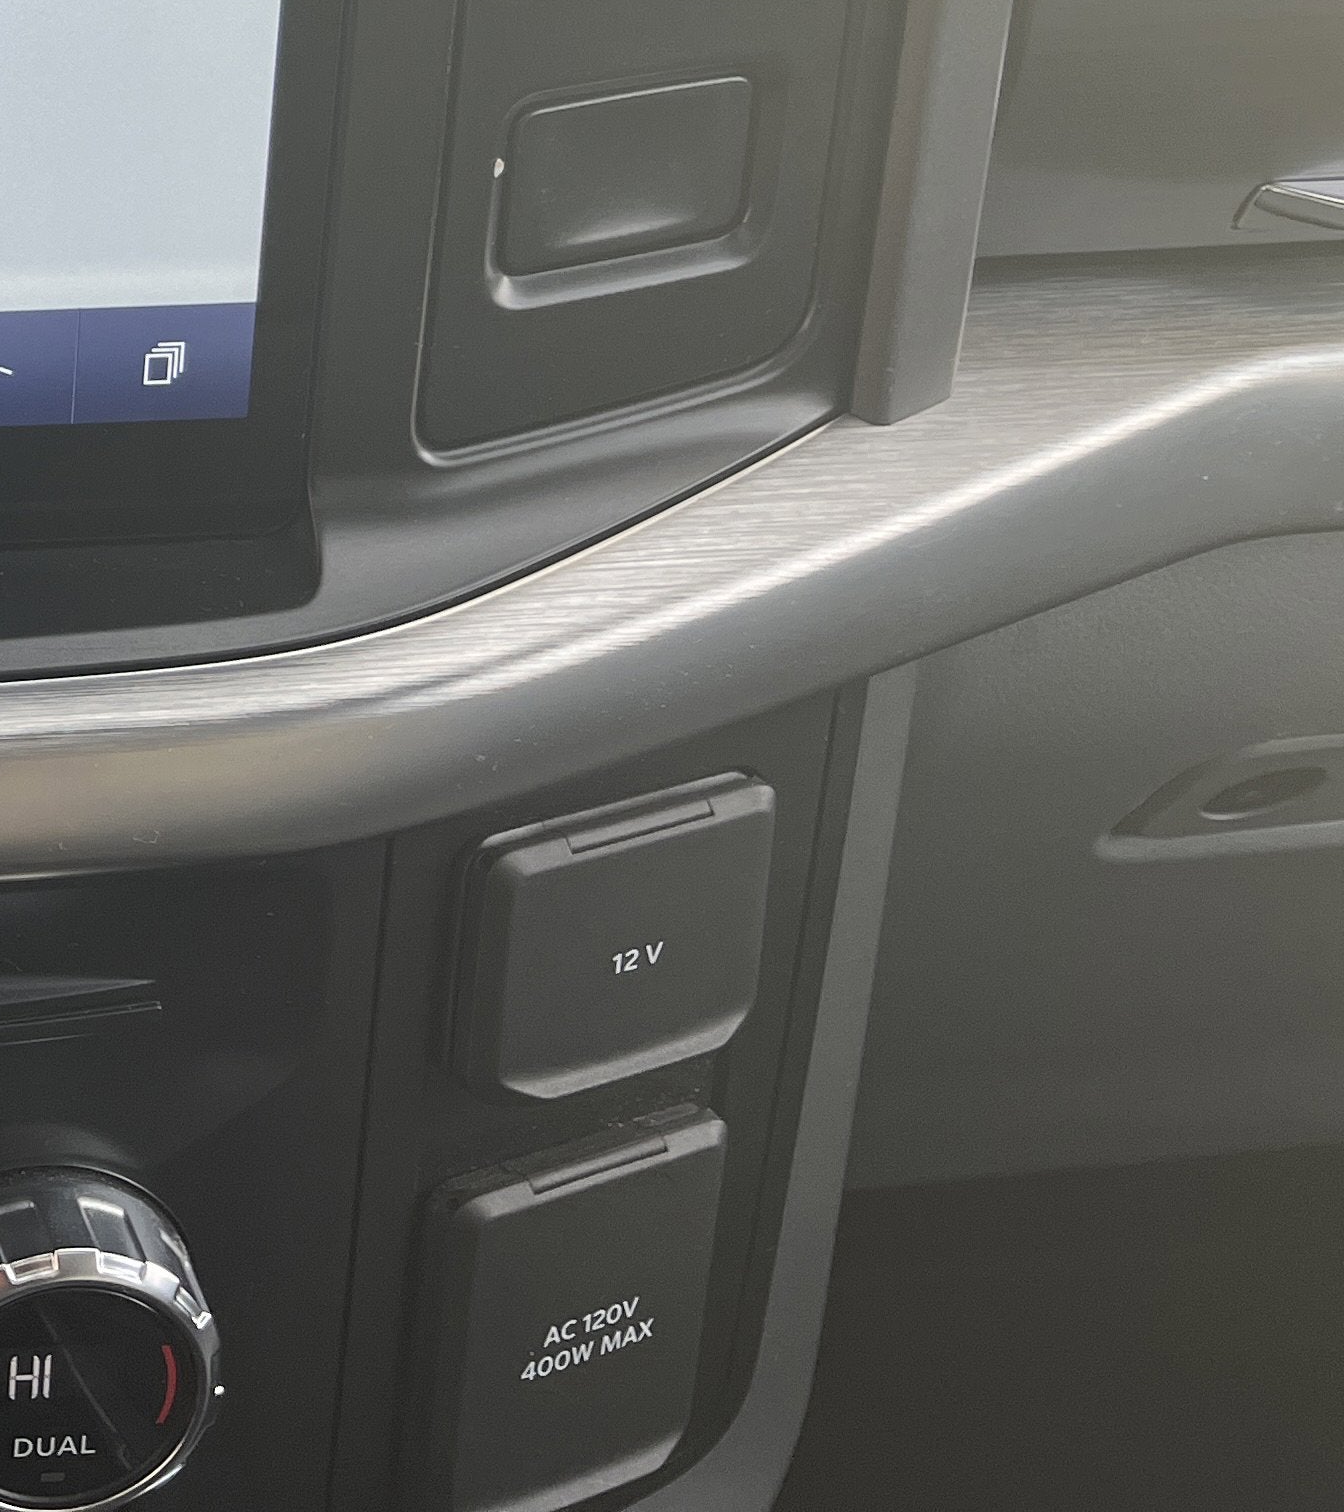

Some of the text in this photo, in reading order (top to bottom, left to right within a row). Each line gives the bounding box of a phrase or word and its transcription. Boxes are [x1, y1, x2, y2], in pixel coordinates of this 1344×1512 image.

[612, 941, 664, 974] 12 V
[543, 1296, 639, 1348] AC 120V
[520, 1318, 654, 1381] 400W MAX
[8, 1354, 52, 1400] HI
[13, 1435, 96, 1458] DUAL
